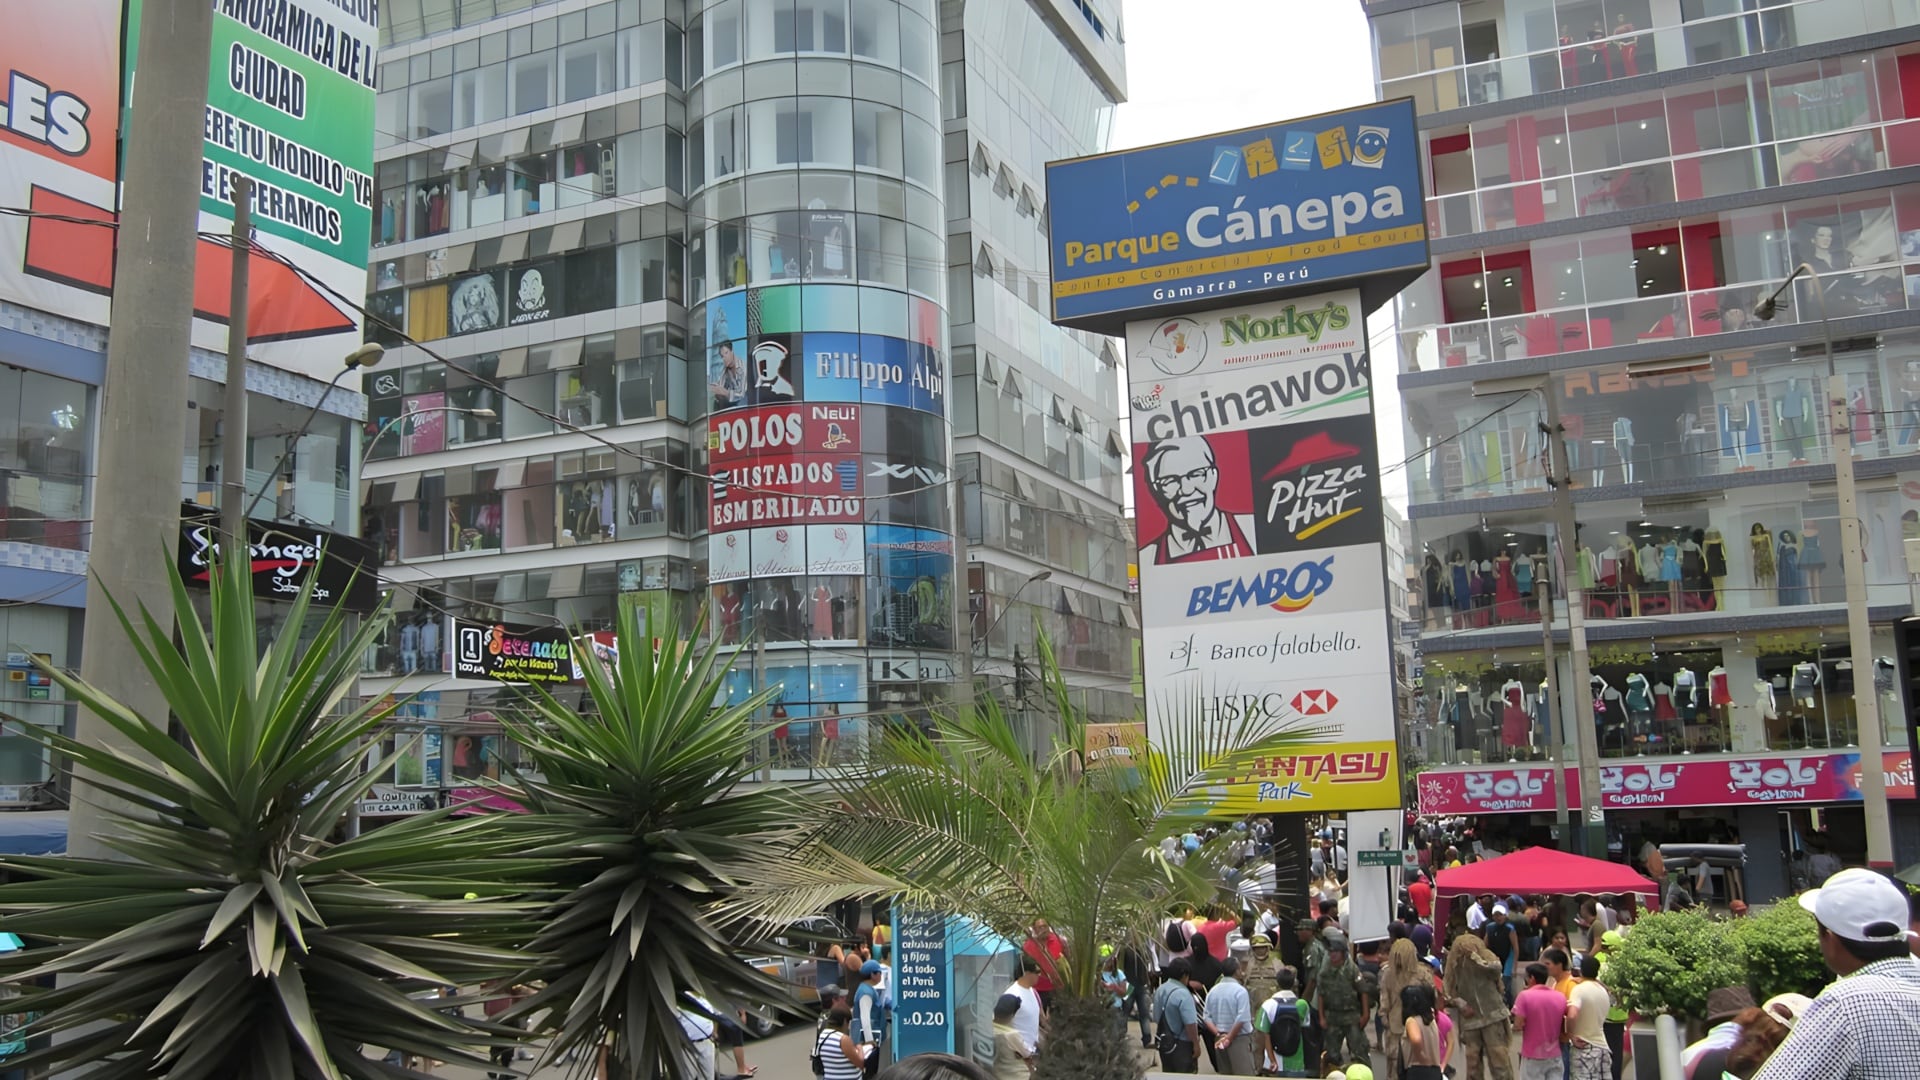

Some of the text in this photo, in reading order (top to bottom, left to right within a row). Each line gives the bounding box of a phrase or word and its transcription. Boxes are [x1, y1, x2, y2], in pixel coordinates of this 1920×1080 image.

[338, 31, 361, 80] DE
[230, 42, 305, 119] CIUDAD
[0, 69, 91, 157] ES
[238, 121, 264, 161] TU
[268, 132, 344, 196] MODULO
[1065, 185, 1405, 266] Parque Cánepa
[1153, 280, 1236, 300] Gamarra
[1263, 266, 1309, 284] Perú
[1220, 300, 1351, 347] Norky's
[815, 352, 903, 390] Filippo
[1147, 352, 1369, 440] chinawok
[718, 412, 803, 453] POLOS
[733, 462, 833, 490] LISTADOS
[1266, 464, 1366, 524] Pizza
[714, 496, 861, 526] ESMERILADO
[1285, 489, 1358, 533] Hut
[1186, 555, 1335, 617] BEMBOS
[488, 624, 568, 659] Serenata
[1211, 644, 1267, 661] Banco
[1201, 692, 1285, 722] HSBC
[1227, 752, 1390, 783] ANTASY
[902, 952, 931, 963] y fijos
[902, 964, 936, 974] de todo
[902, 976, 934, 986] el Perú
[902, 989, 917, 999] por
